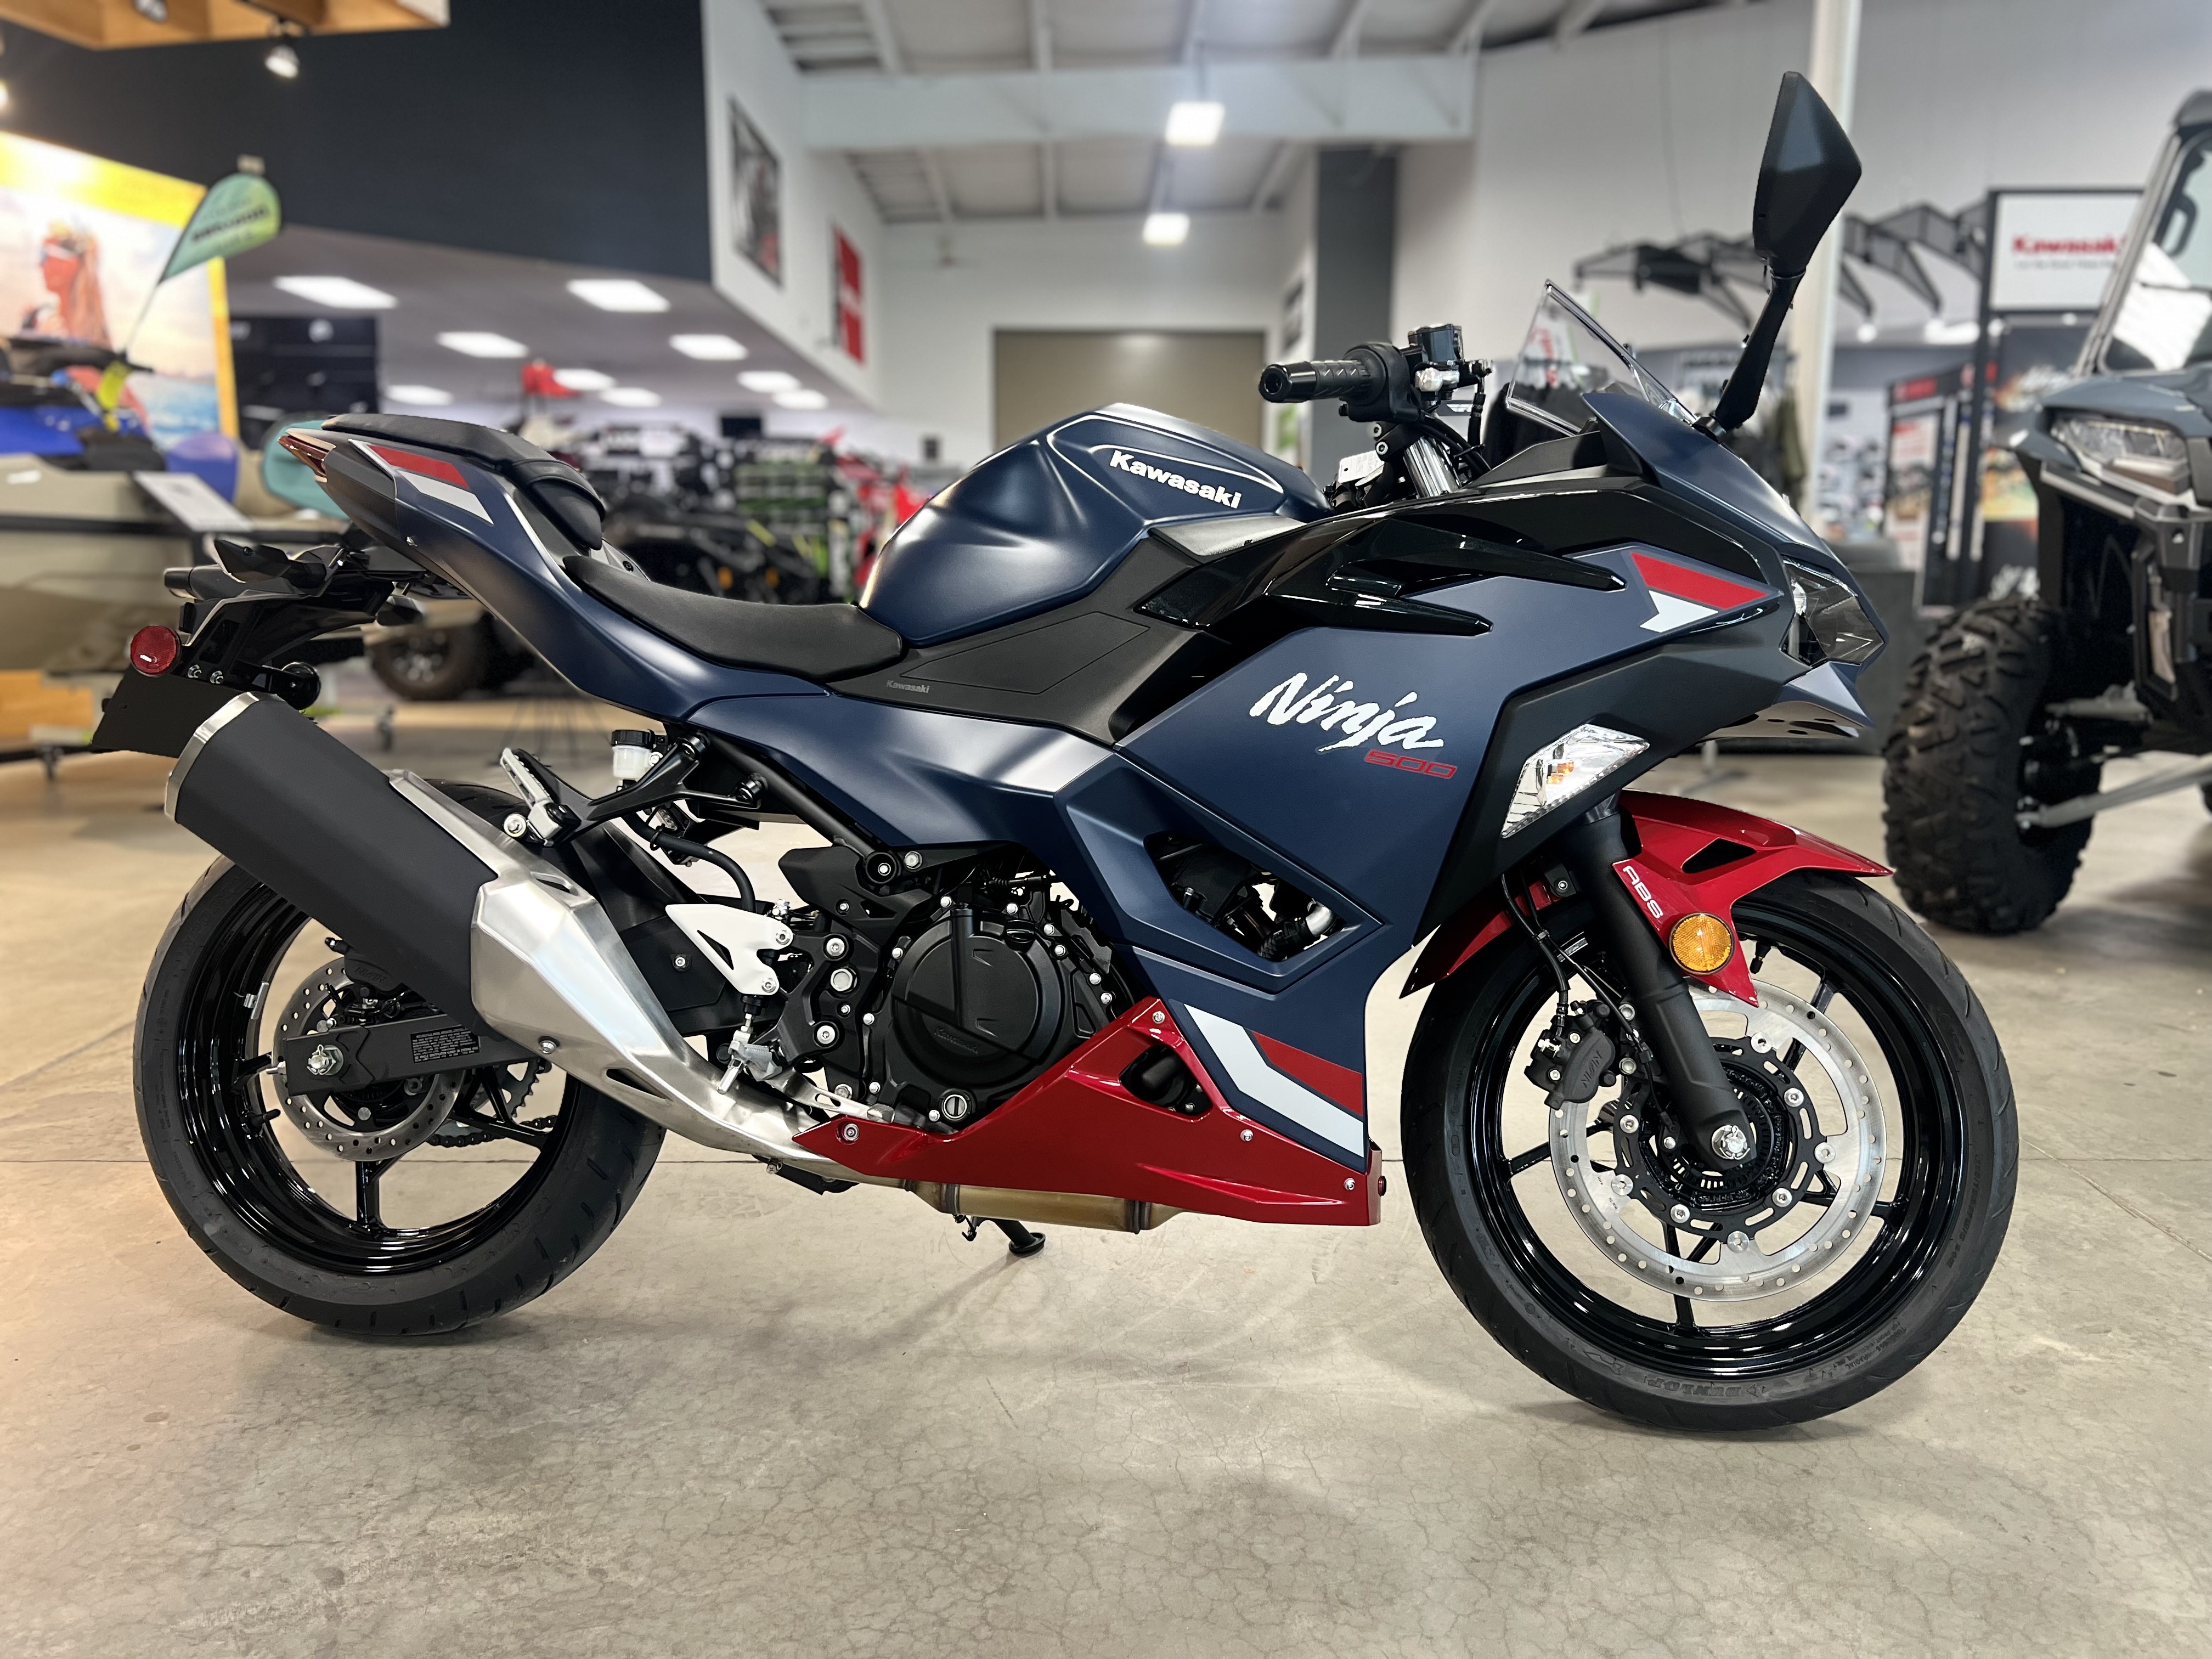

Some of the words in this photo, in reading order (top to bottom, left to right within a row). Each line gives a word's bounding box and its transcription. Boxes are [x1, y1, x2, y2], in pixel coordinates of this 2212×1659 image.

[1109, 450, 1242, 509] Kawasaki
[886, 680, 930, 693] Kawasaki
[1249, 672, 1444, 752] Ninja
[1364, 749, 1458, 780] 500
[1622, 865, 1664, 919] ABS
